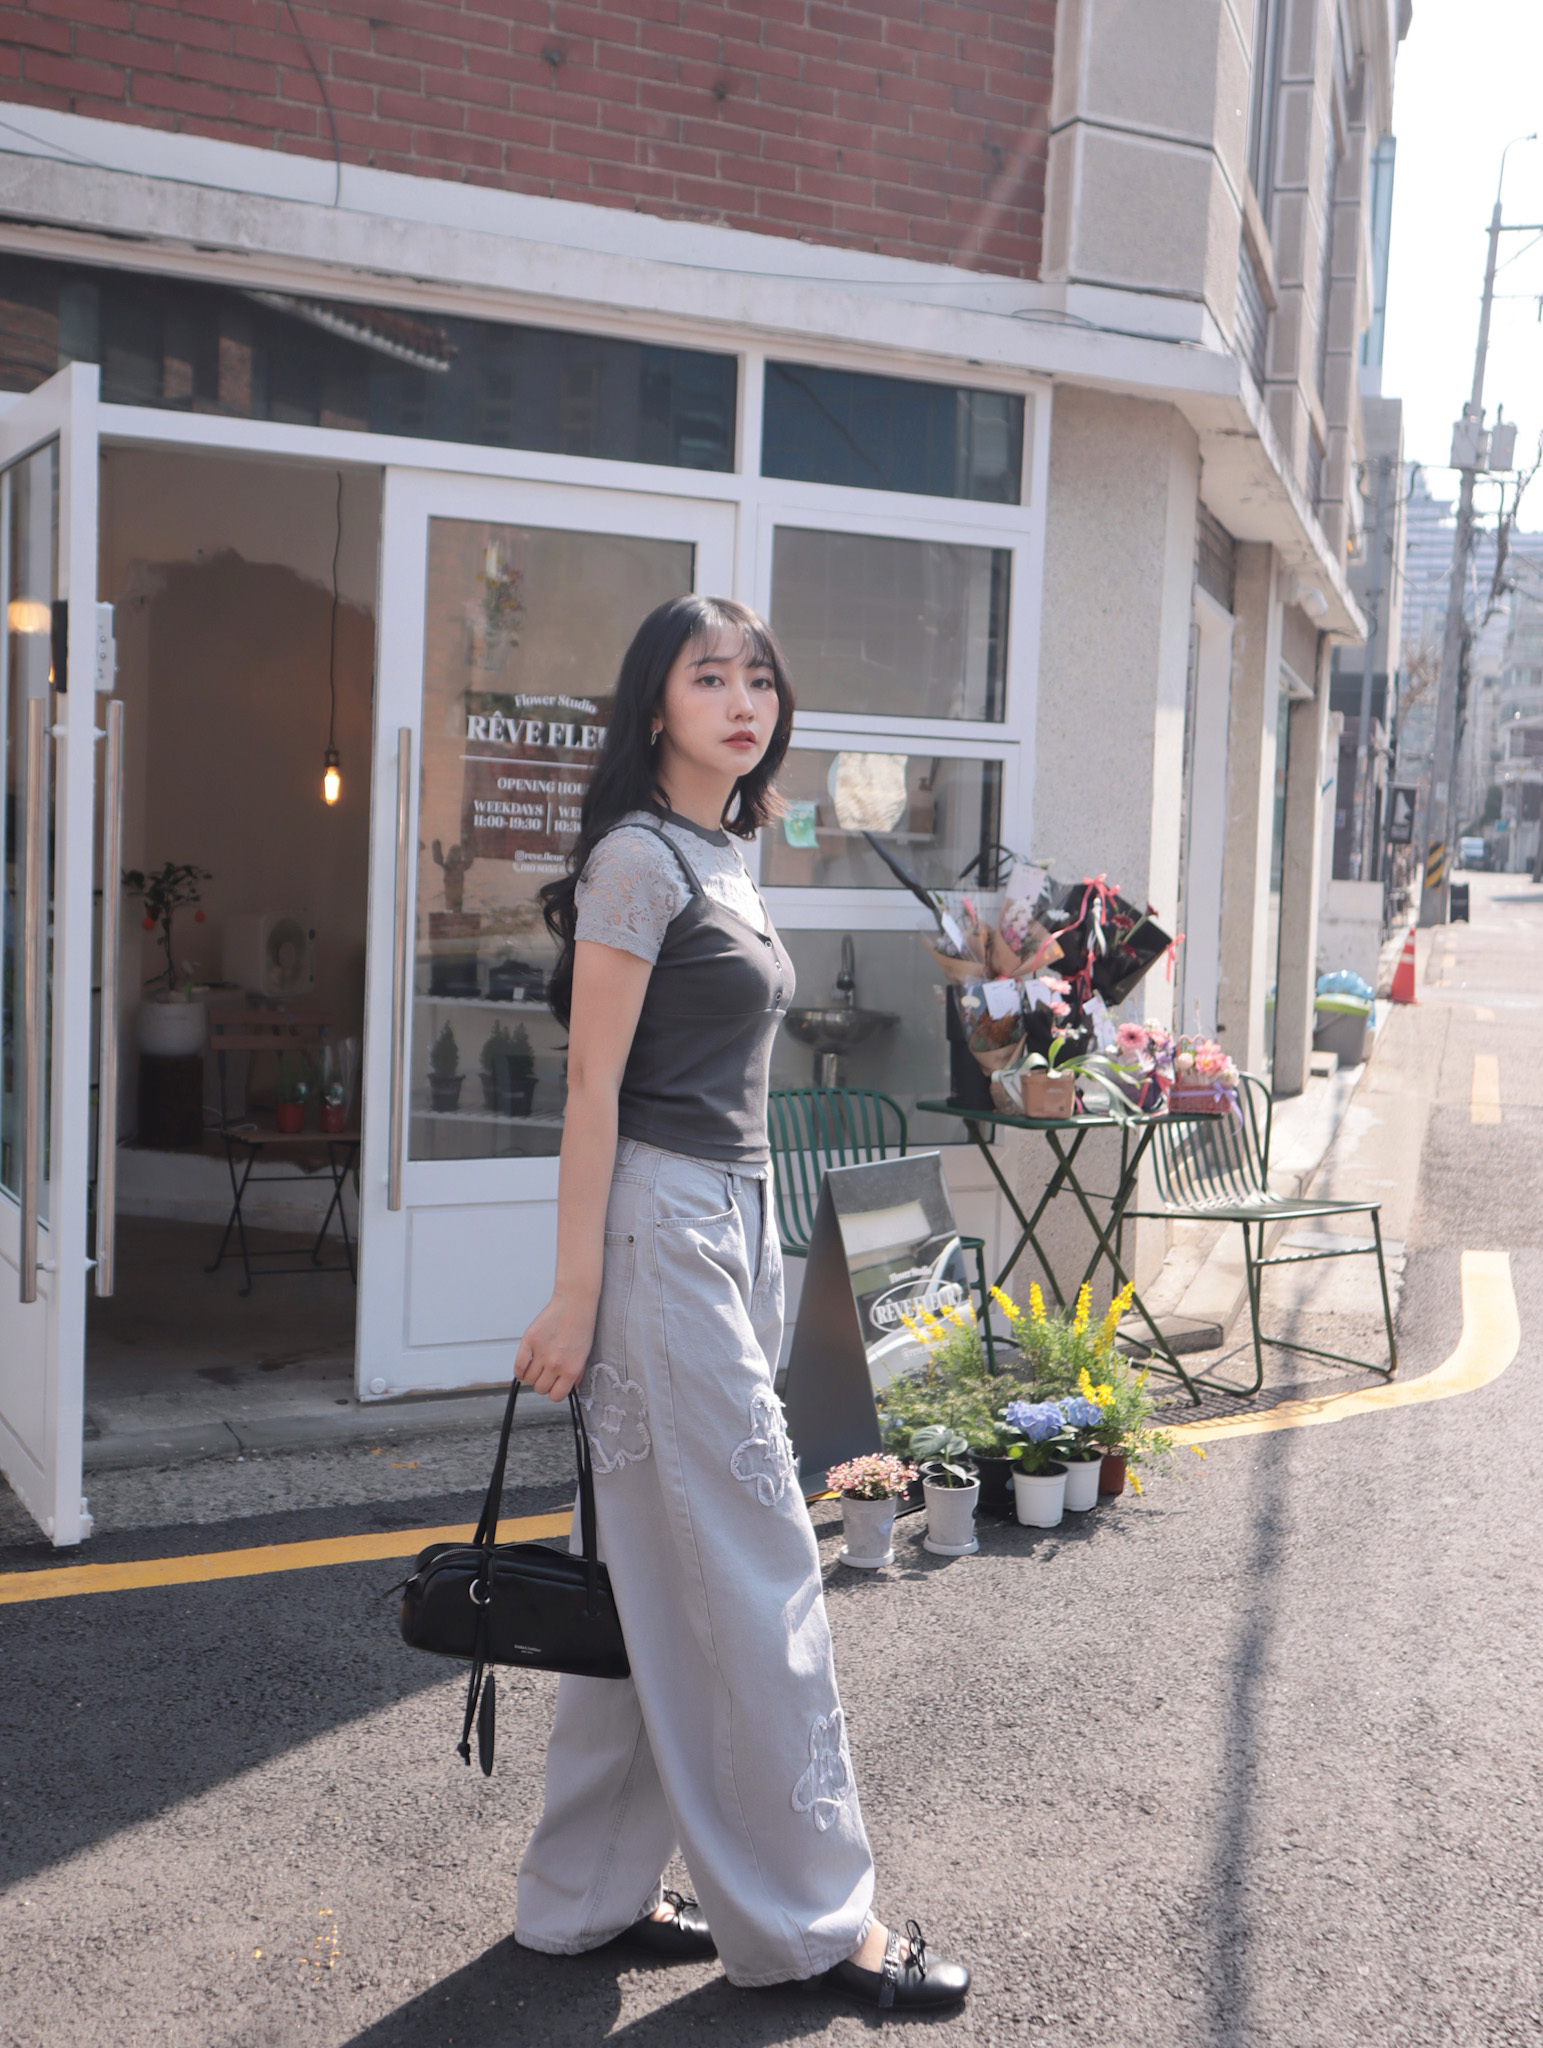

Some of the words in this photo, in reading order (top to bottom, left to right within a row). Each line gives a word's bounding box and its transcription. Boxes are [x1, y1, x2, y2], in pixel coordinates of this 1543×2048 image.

[514, 694, 556, 708] Flower
[558, 694, 598, 715] Studio
[466, 710, 543, 746] RÊVE
[497, 777, 556, 794] OPENING
[474, 800, 545, 817] WEEKDAYS
[474, 814, 542, 831] 11:00-19:30
[875, 1298, 915, 1324] RÊVE
